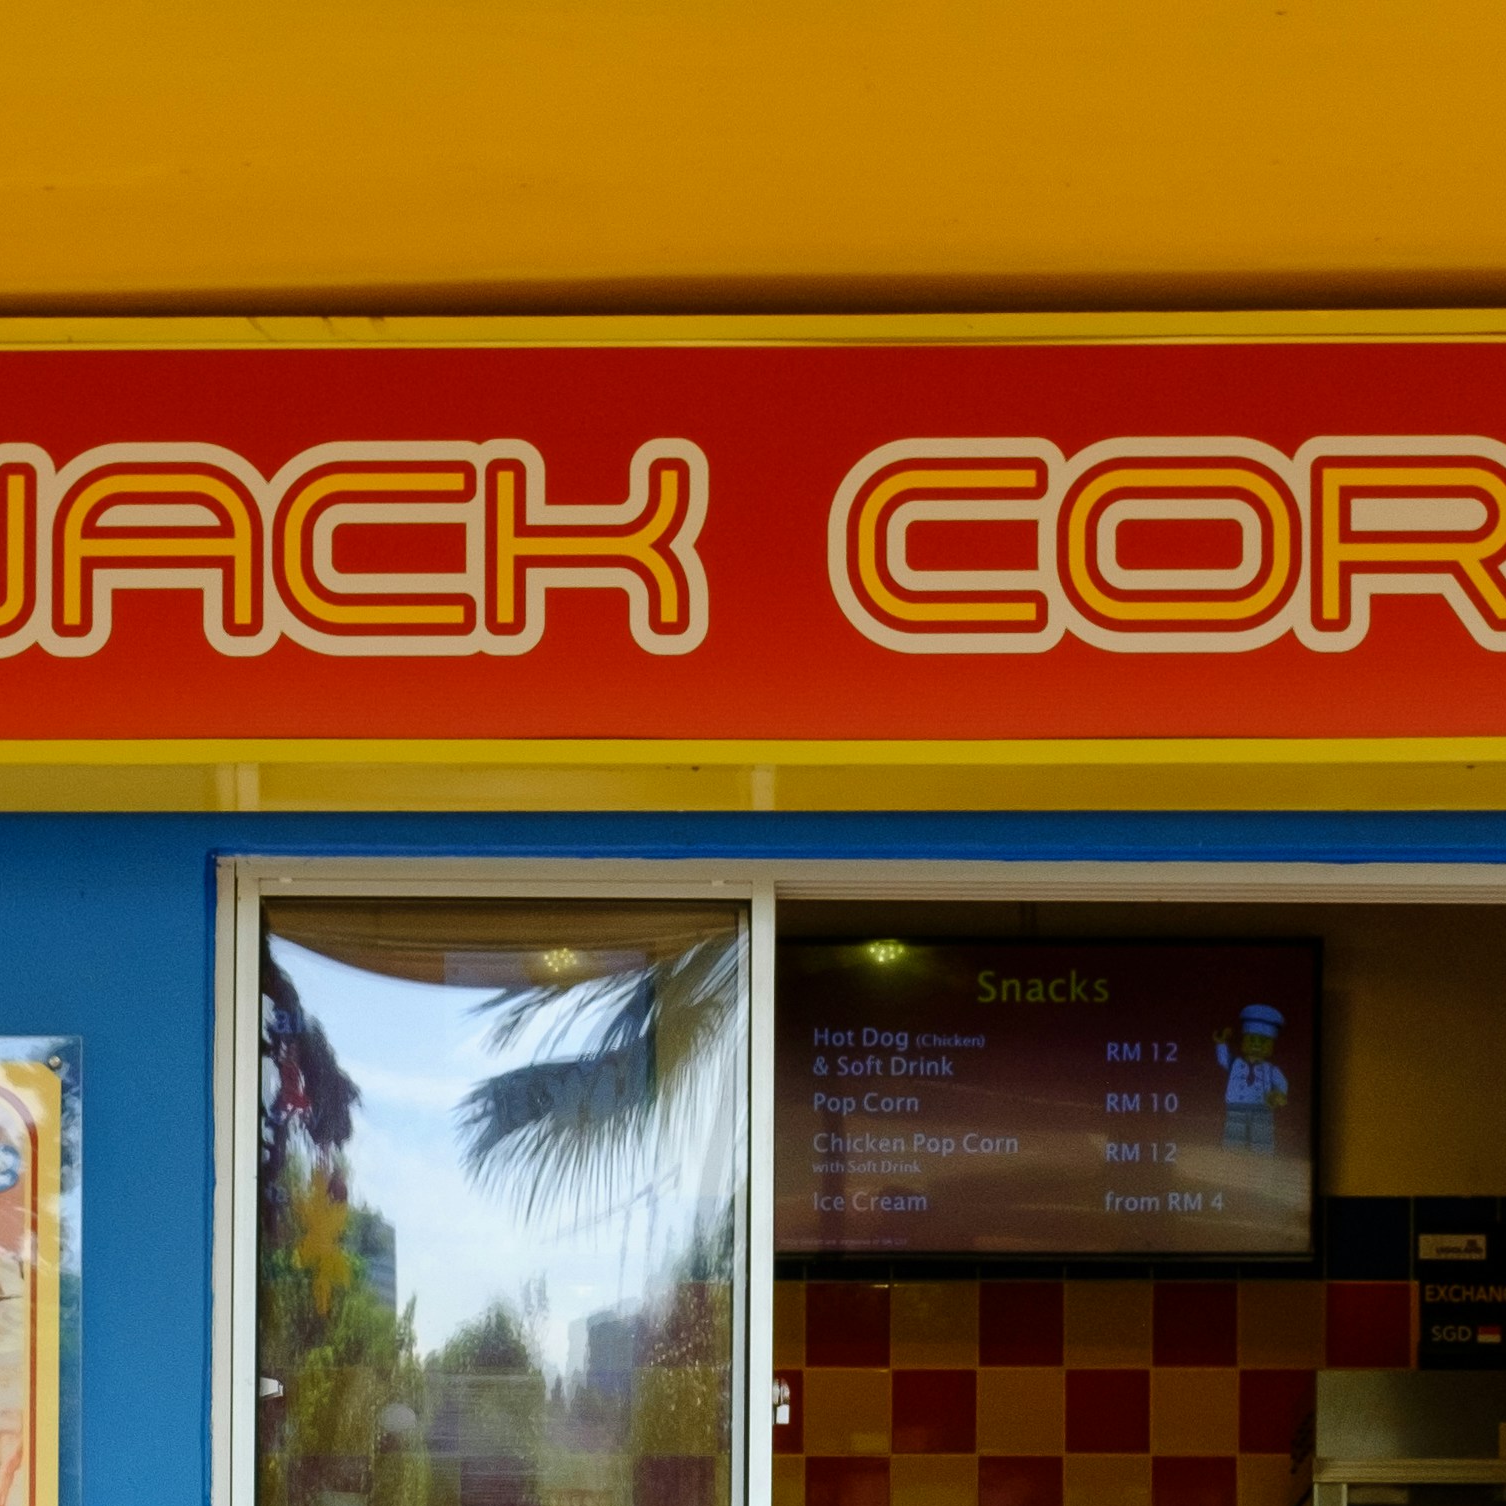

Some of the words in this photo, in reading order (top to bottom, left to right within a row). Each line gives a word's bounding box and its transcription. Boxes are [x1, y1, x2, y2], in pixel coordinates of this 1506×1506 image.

[977, 970, 1110, 1003] Snacks
[813, 1027, 856, 1048] Hot
[862, 1028, 910, 1052] Dog
[915, 1033, 986, 1049] (Chicken)
[1106, 1042, 1141, 1062] RM
[1151, 1042, 1178, 1062] 12
[812, 1057, 829, 1077] &
[836, 1056, 884, 1077] Soft
[890, 1056, 954, 1077] Drink
[813, 1093, 856, 1116] Pop
[863, 1093, 919, 1113] Corn
[1106, 1093, 1141, 1113] RM
[1151, 1093, 1178, 1113] 10
[813, 1133, 905, 1154] Chicken
[912, 1134, 955, 1158] Pop
[962, 1134, 1019, 1154] Corn
[1106, 1144, 1141, 1163] RM
[1151, 1143, 1177, 1163] 12
[812, 1159, 845, 1173] with
[847, 1159, 878, 1173] Soft
[880, 1159, 921, 1174] Drink
[812, 1191, 845, 1212] Ice
[851, 1191, 928, 1212] Cream
[1105, 1192, 1160, 1212] from
[1167, 1193, 1205, 1212] RM
[1211, 1192, 1225, 1212] 4
[1431, 1325, 1472, 1342] SGD
